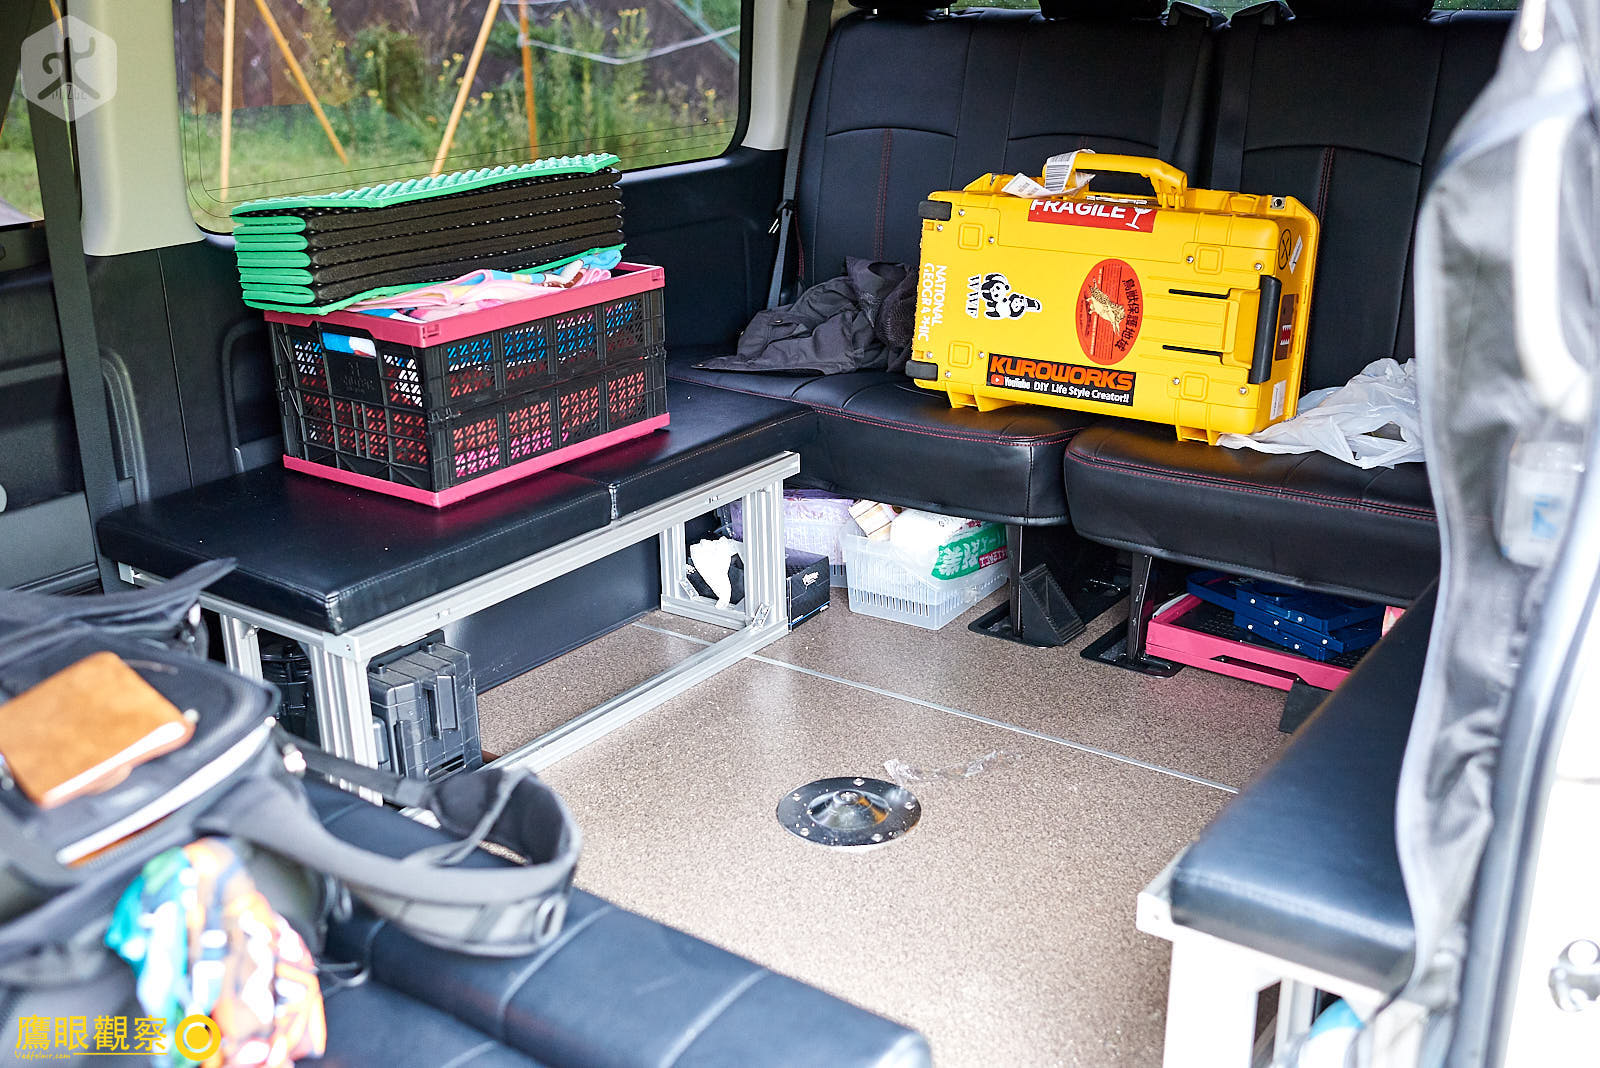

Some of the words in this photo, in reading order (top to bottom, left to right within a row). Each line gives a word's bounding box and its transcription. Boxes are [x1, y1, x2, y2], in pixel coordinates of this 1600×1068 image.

[1030, 199, 1126, 219] FRAGILE
[931, 264, 948, 327] NATIONAL
[967, 275, 980, 317] WWF
[990, 355, 1134, 391] KUROWORKS
[1033, 381, 1050, 392] DIY
[1051, 383, 1068, 395] Life
[1068, 385, 1090, 399] Style
